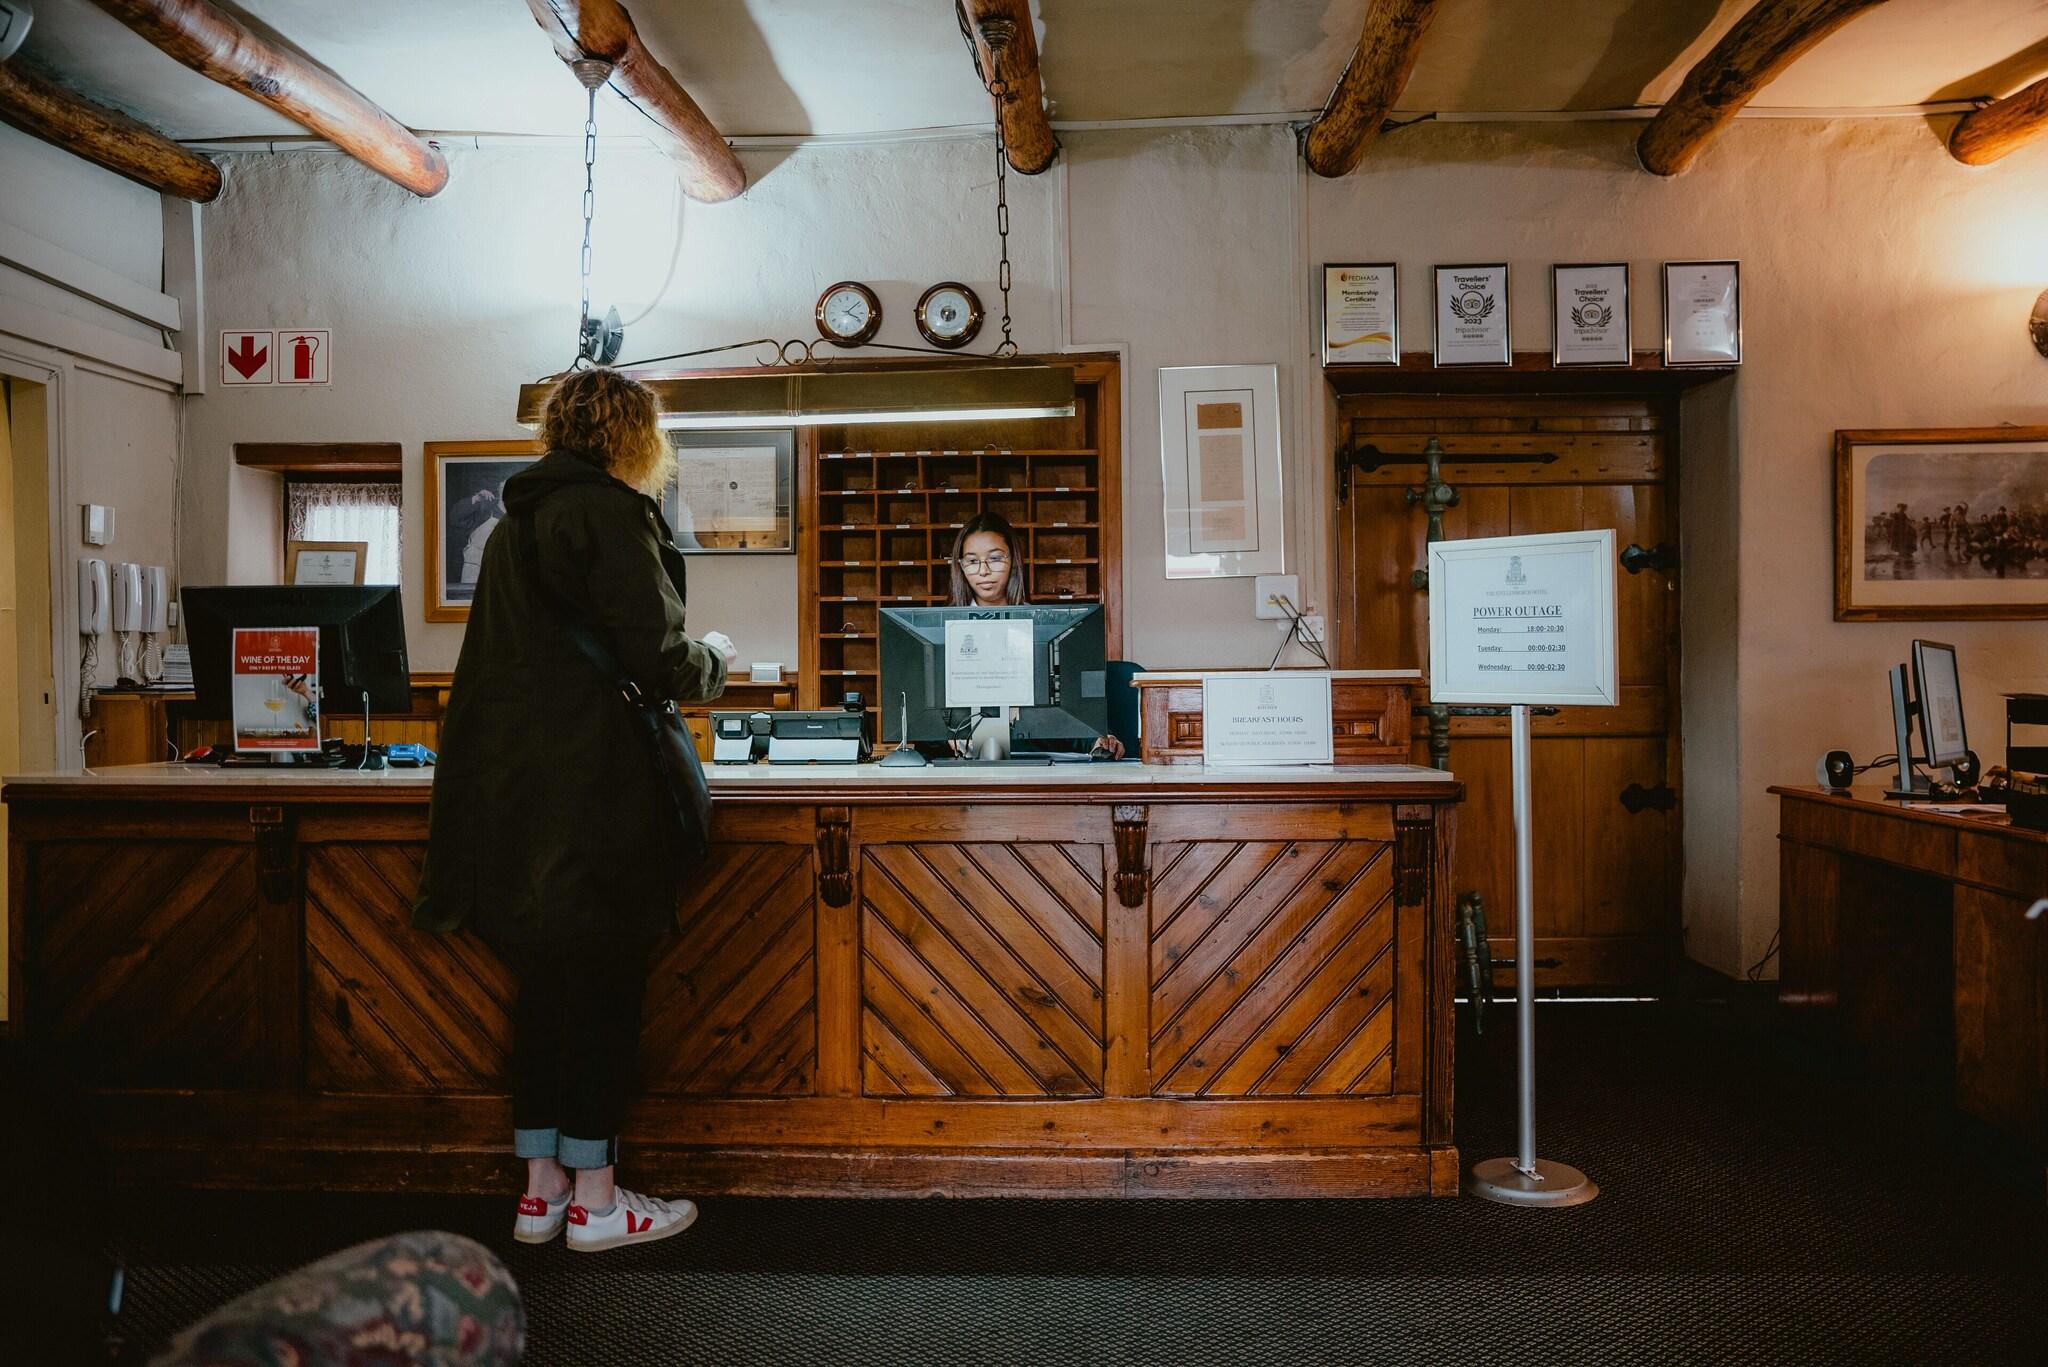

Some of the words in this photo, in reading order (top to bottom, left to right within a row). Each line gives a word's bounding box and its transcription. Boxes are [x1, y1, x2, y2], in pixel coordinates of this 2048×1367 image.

[1578, 295, 1604, 303] Choice
[1473, 607, 1512, 617] POWER
[1514, 605, 1563, 616] OUTAGE
[1478, 626, 1502, 634] Monday:
[1478, 645, 1503, 653] Tuesday:
[1527, 644, 1566, 652] 00:00-02:30
[1478, 663, 1513, 671] Wednesday:
[1527, 663, 1566, 671] 00:00-02:30
[520, 1202, 538, 1211] VEJA
